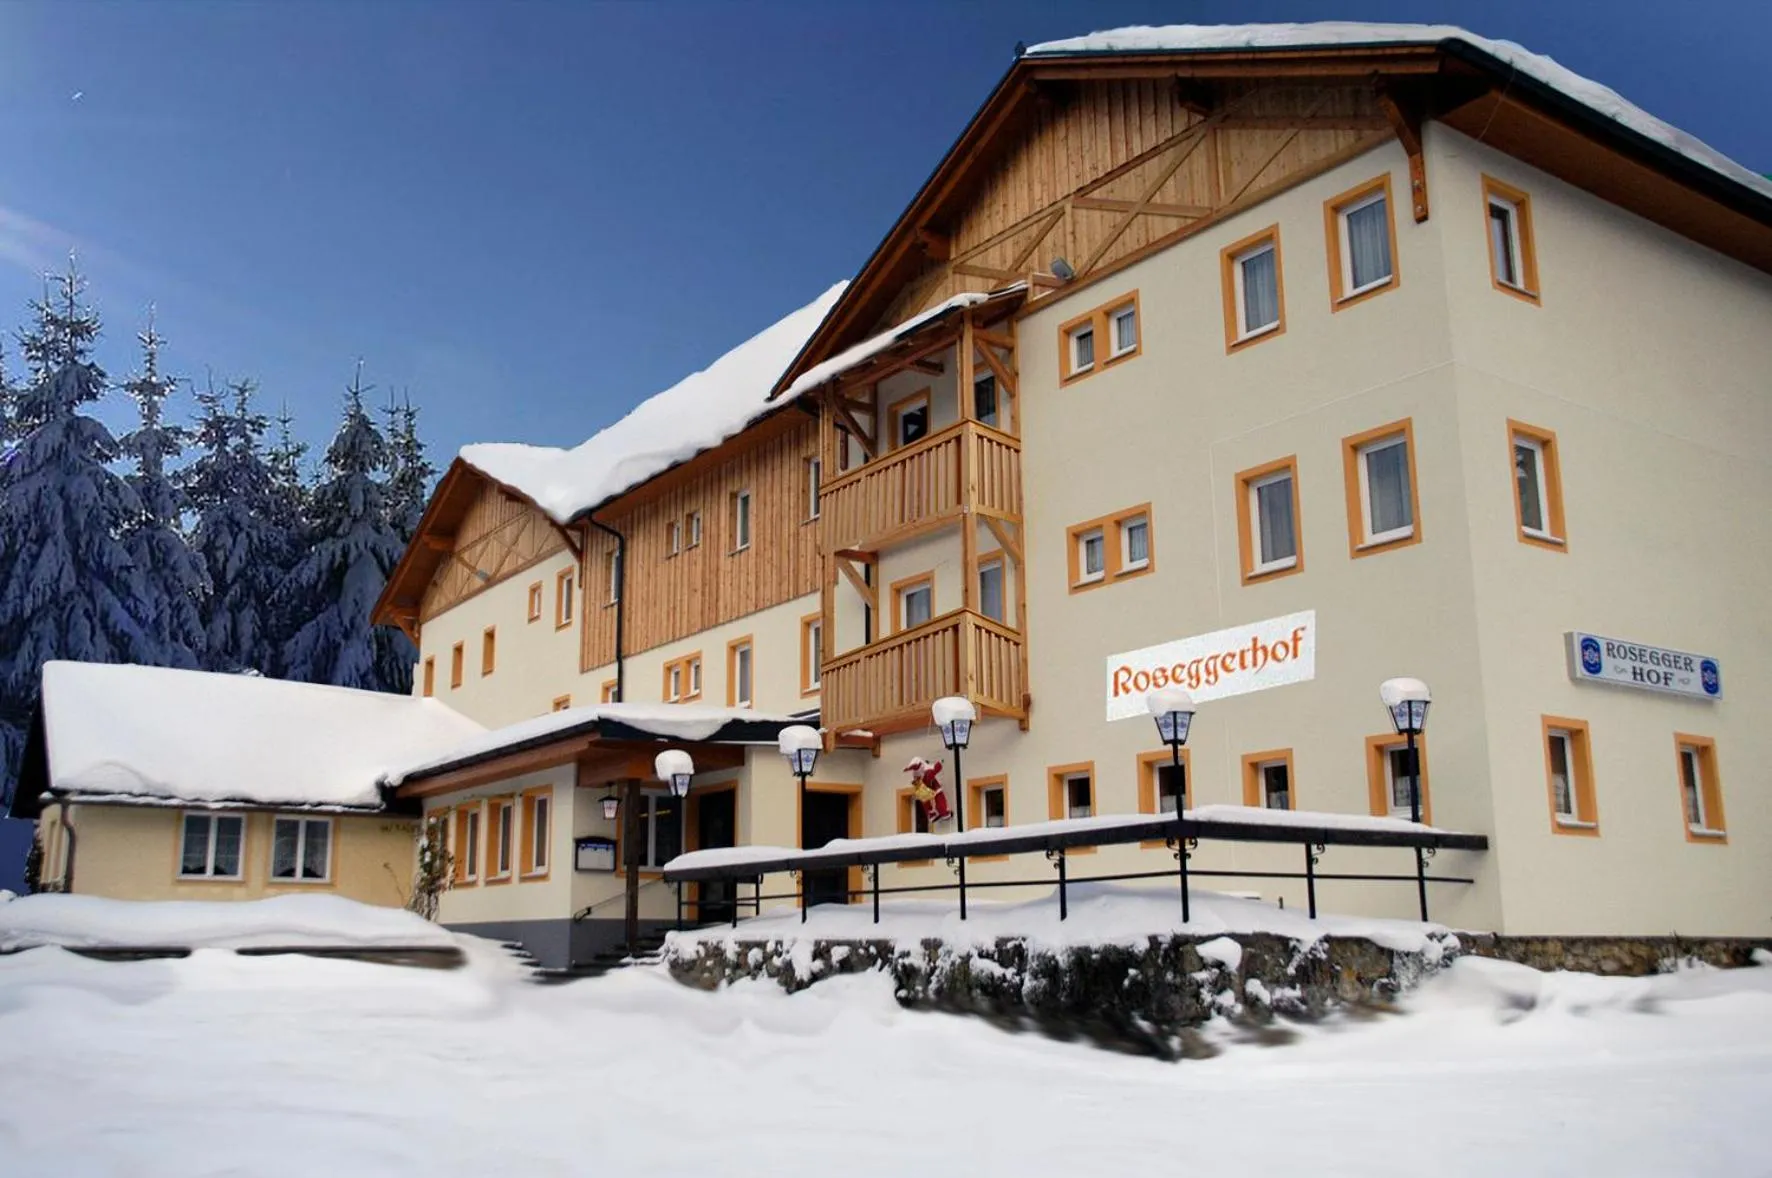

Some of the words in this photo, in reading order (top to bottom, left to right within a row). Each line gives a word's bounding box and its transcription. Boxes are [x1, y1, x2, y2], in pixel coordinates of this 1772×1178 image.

[1112, 625, 1307, 698] Roseggerhof
[1605, 641, 1696, 673] ROSEGGER
[1631, 665, 1675, 687] HOF
